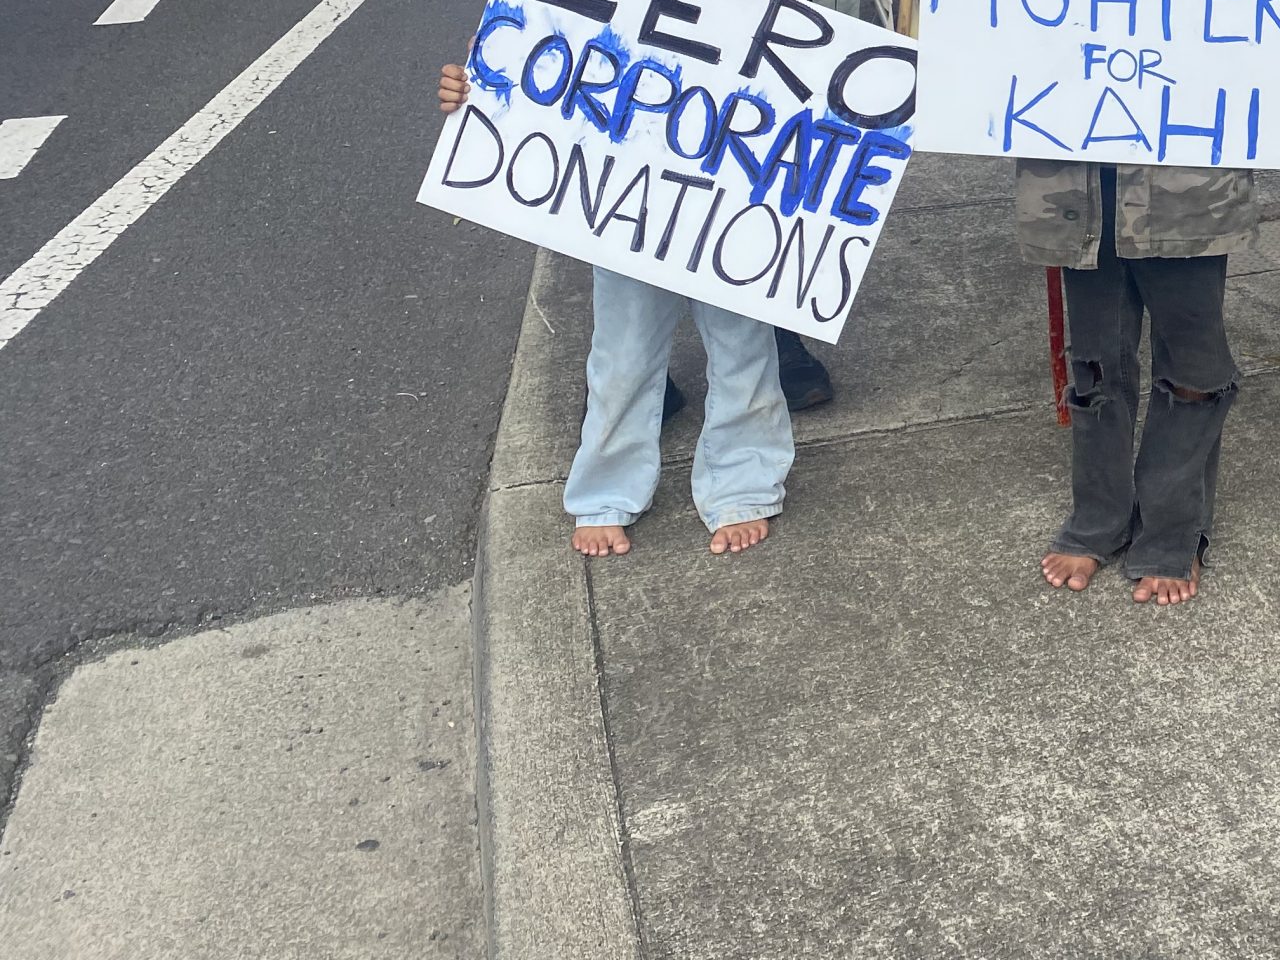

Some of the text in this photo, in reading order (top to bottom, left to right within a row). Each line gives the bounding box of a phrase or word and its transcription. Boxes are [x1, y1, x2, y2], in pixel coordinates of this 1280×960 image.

[465, 2, 913, 226] CORPORATE
[1002, 74, 1260, 165] KAHI
[1082, 43, 1177, 89] FOR
[441, 104, 870, 323] DONATIONS
